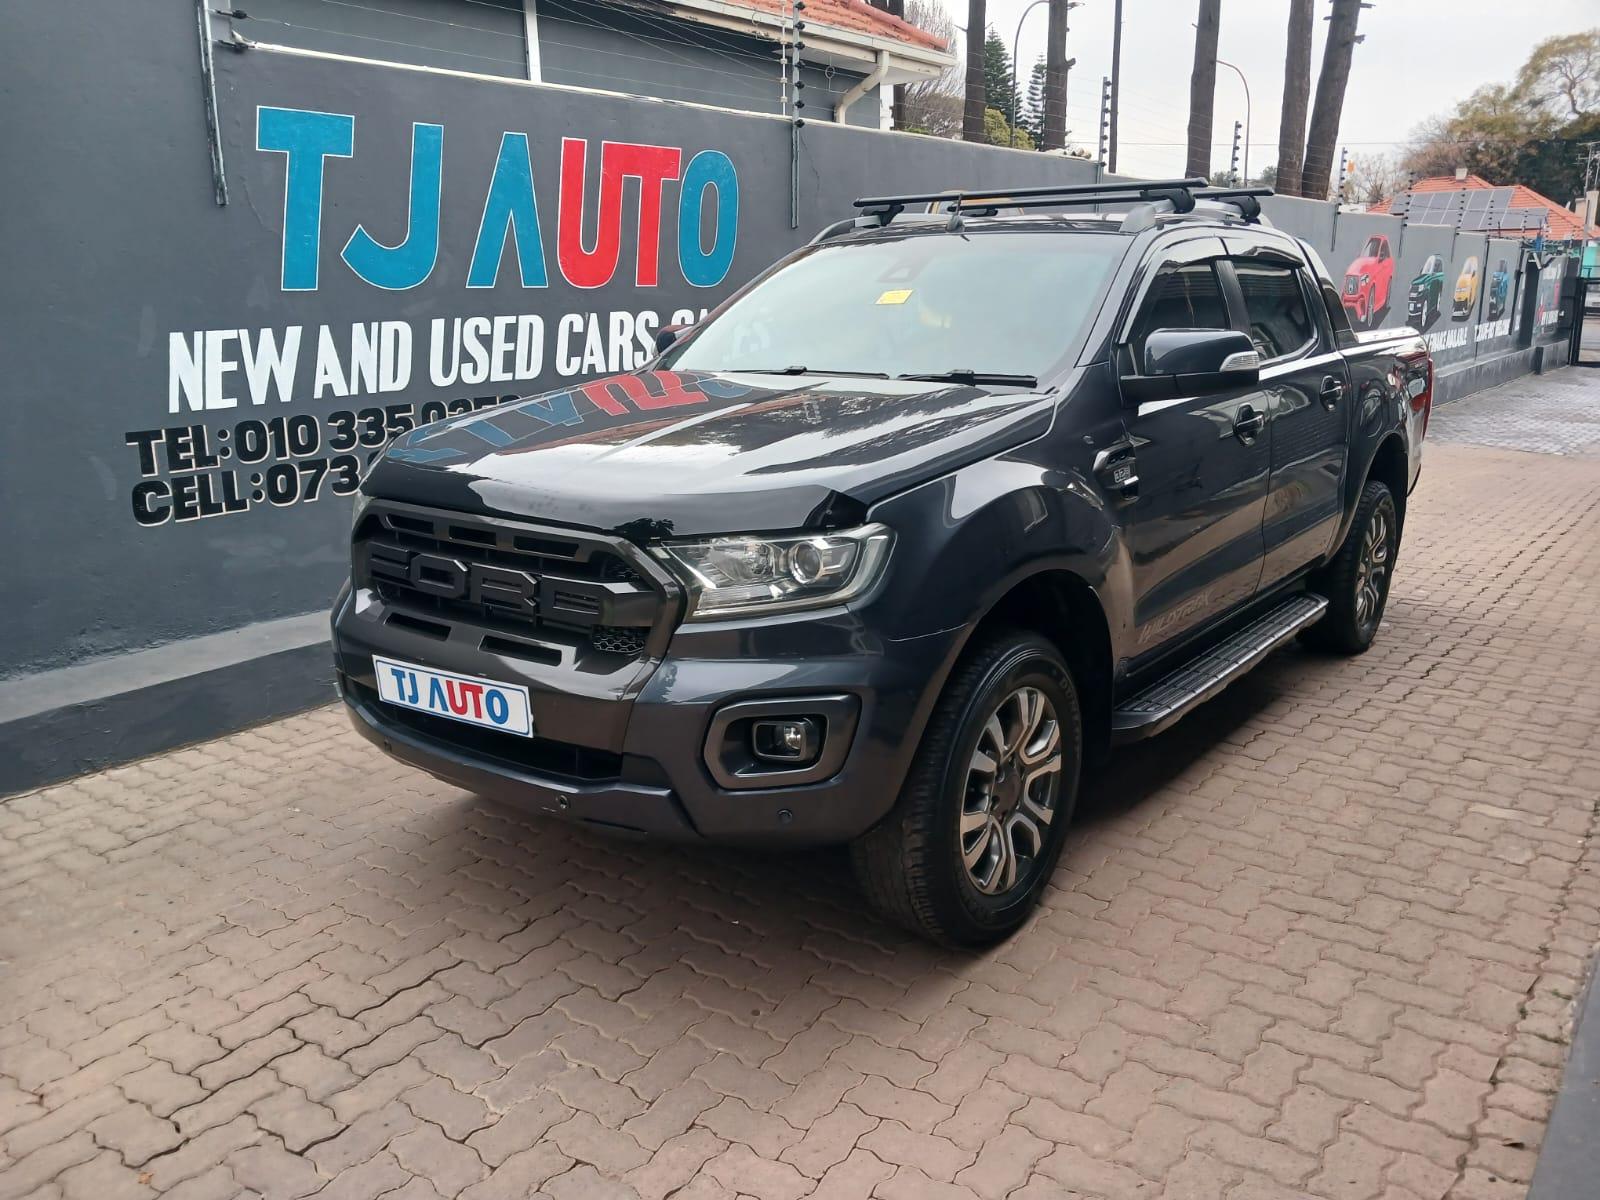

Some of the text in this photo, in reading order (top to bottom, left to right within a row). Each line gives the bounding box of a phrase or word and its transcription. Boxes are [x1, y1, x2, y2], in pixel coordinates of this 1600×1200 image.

[255, 105, 740, 291] TJ AUTO
[168, 309, 659, 413] NEW AND USED CARS
[125, 414, 320, 478] TEL:010
[327, 403, 416, 453] 335
[131, 454, 362, 528] CELL:073
[391, 666, 510, 726] TJ AUTO
